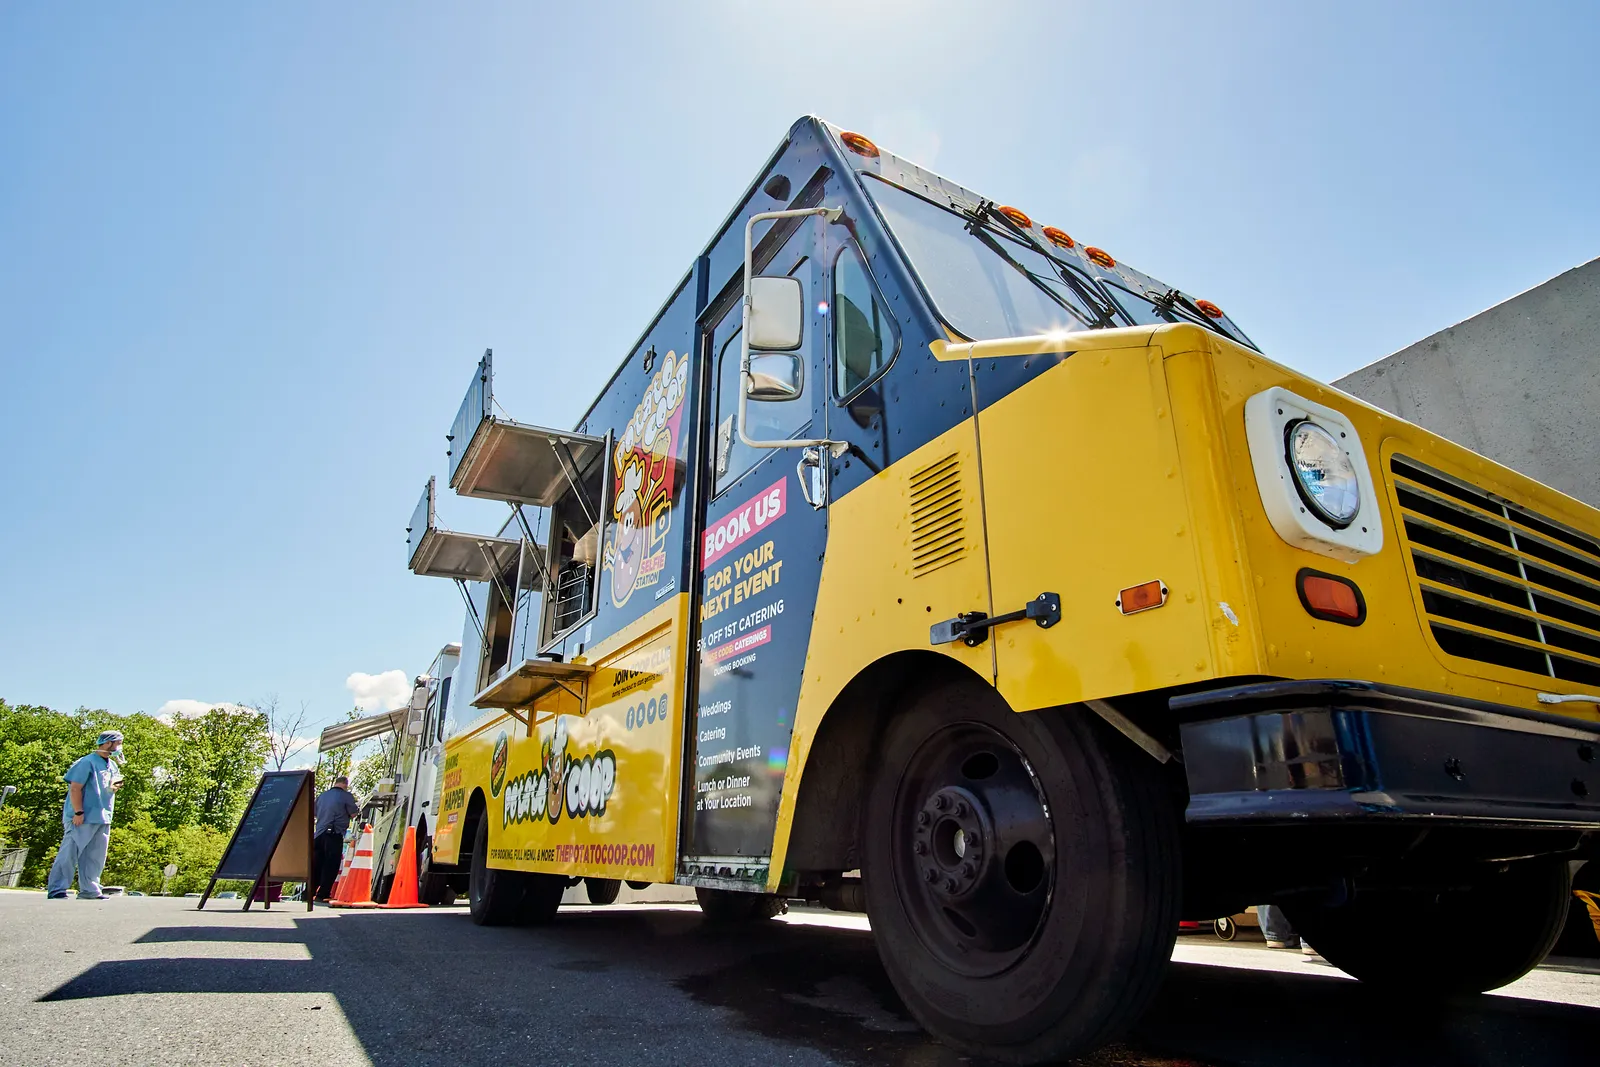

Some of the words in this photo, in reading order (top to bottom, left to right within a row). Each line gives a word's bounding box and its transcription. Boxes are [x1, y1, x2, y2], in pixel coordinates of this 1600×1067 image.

[704, 505, 751, 560] BOOK
[754, 488, 781, 526] US
[640, 553, 665, 575] SELFIE
[707, 565, 731, 597] FOR
[734, 540, 774, 574] YOUR
[635, 570, 659, 588] STATION
[700, 592, 731, 624] NEXT
[734, 560, 783, 605] EVENT
[708, 627, 723, 646] OFF
[724, 621, 738, 639] 1ST
[739, 599, 784, 631] CATERING
[713, 662, 732, 676] DURING
[732, 653, 757, 669] BOOKING
[612, 669, 629, 687] JOIN
[700, 699, 732, 718] Weddings
[699, 726, 726, 743] Catering
[698, 748, 735, 767] Community
[736, 744, 761, 761] Events
[566, 754, 615, 815] COOP
[697, 778, 717, 793] Lunch
[717, 780, 725, 791] or
[726, 775, 751, 788] Dinner
[696, 800, 703, 811] at
[704, 798, 720, 811] Your
[720, 794, 752, 809] Location
[514, 848, 523, 860] FULL
[541, 849, 555, 862] MORE
[556, 844, 655, 867] THEPOTATOCOOP.COM
